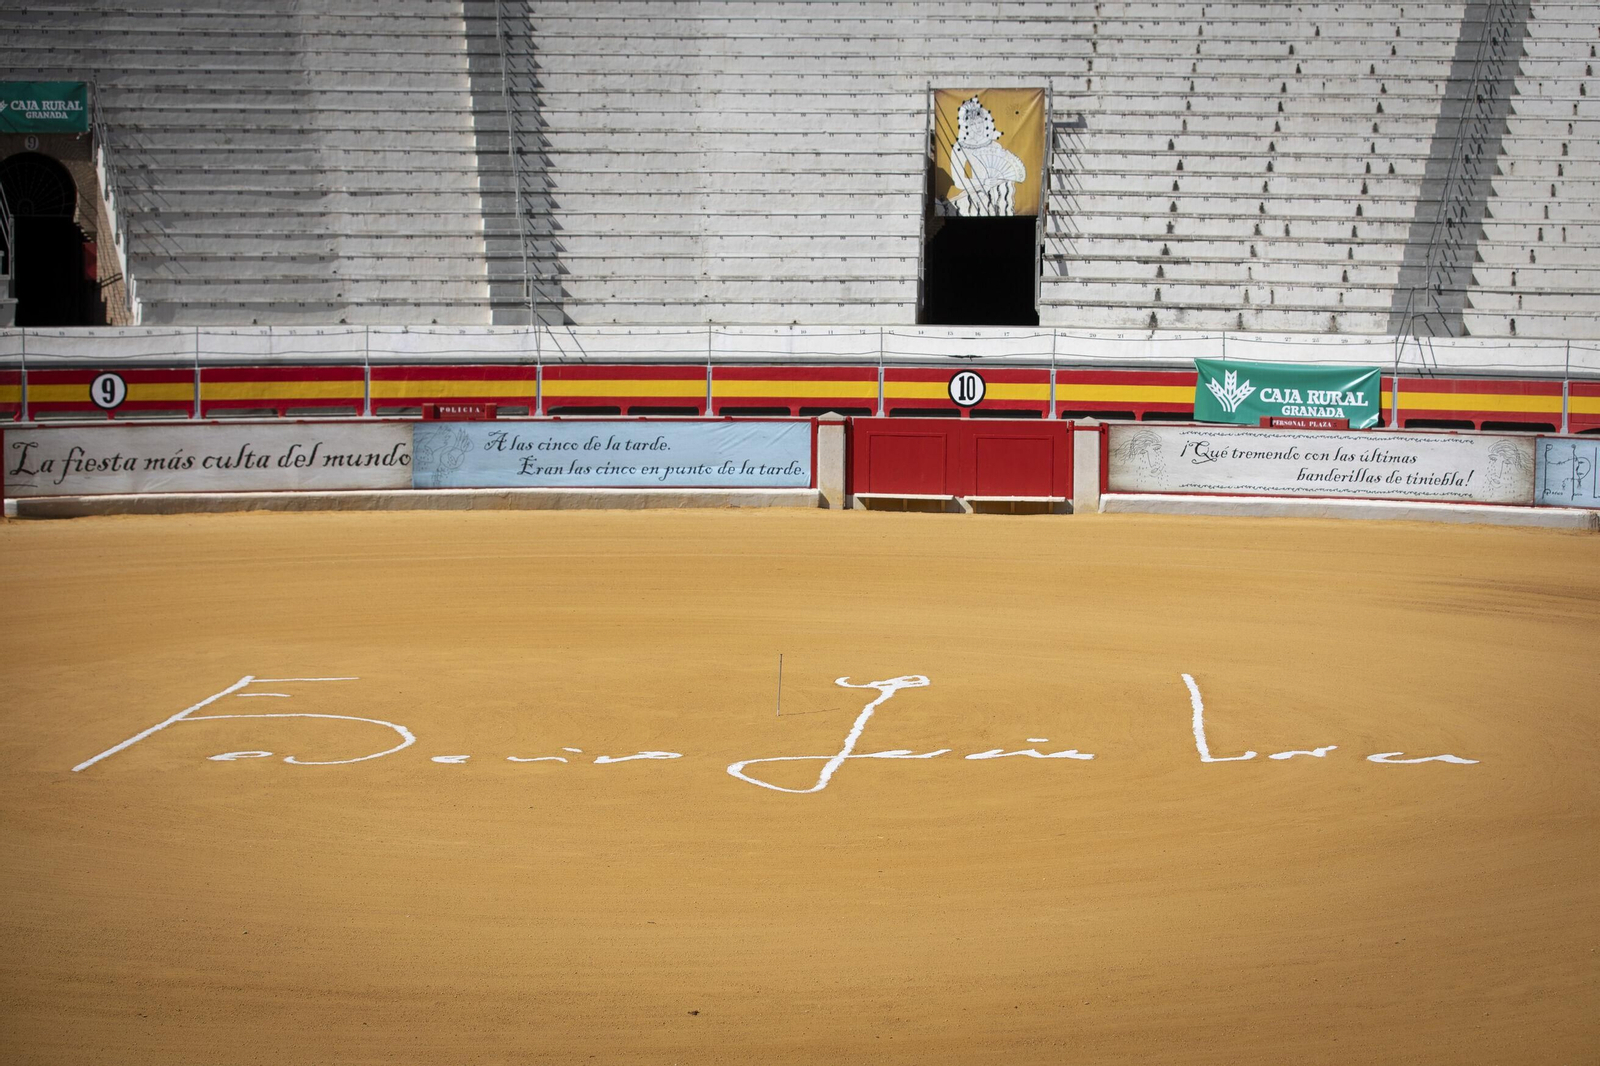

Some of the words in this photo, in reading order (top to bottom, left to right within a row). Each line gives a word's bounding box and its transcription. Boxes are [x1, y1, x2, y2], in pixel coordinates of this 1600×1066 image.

[10, 100, 41, 111] CAJA
[42, 100, 83, 111] RURAL
[25, 111, 69, 119] GRANADA
[26, 135, 37, 149] 9
[101, 377, 116, 404] 9
[958, 375, 976, 401] 10
[1259, 388, 1304, 404] CAJA
[1307, 390, 1369, 407] RURAL
[439, 406, 481, 414] POLICIA
[1281, 405, 1346, 418] GRANADA
[1271, 419, 1307, 428] PERSONAL
[1309, 421, 1333, 429] PLAZA
[483, 429, 507, 451] A
[509, 431, 534, 451] las
[537, 436, 580, 451] cinco
[583, 434, 602, 451] de
[604, 433, 622, 451] la
[624, 433, 671, 451] tarde.
[1179, 440, 1230, 465] ¡Qué
[1231, 446, 1301, 460] tremendo
[1304, 451, 1330, 461] con
[1333, 447, 1356, 462] las
[1360, 447, 1418, 464] últimas
[9, 441, 56, 476] La
[53, 445, 139, 485] fiesta
[143, 448, 196, 471] más
[202, 442, 272, 470] culta
[276, 441, 323, 468] del
[322, 442, 412, 468] mundo
[517, 454, 564, 476] Eran
[566, 457, 593, 475] las
[595, 462, 637, 476] cinco
[641, 465, 660, 476] en
[658, 464, 714, 482] punto
[717, 459, 736, 476] de
[738, 459, 756, 476] la
[758, 459, 806, 477] tarde.
[1296, 467, 1382, 484] banderillas
[1385, 469, 1402, 484] de
[1406, 469, 1475, 487] tiniebla!
